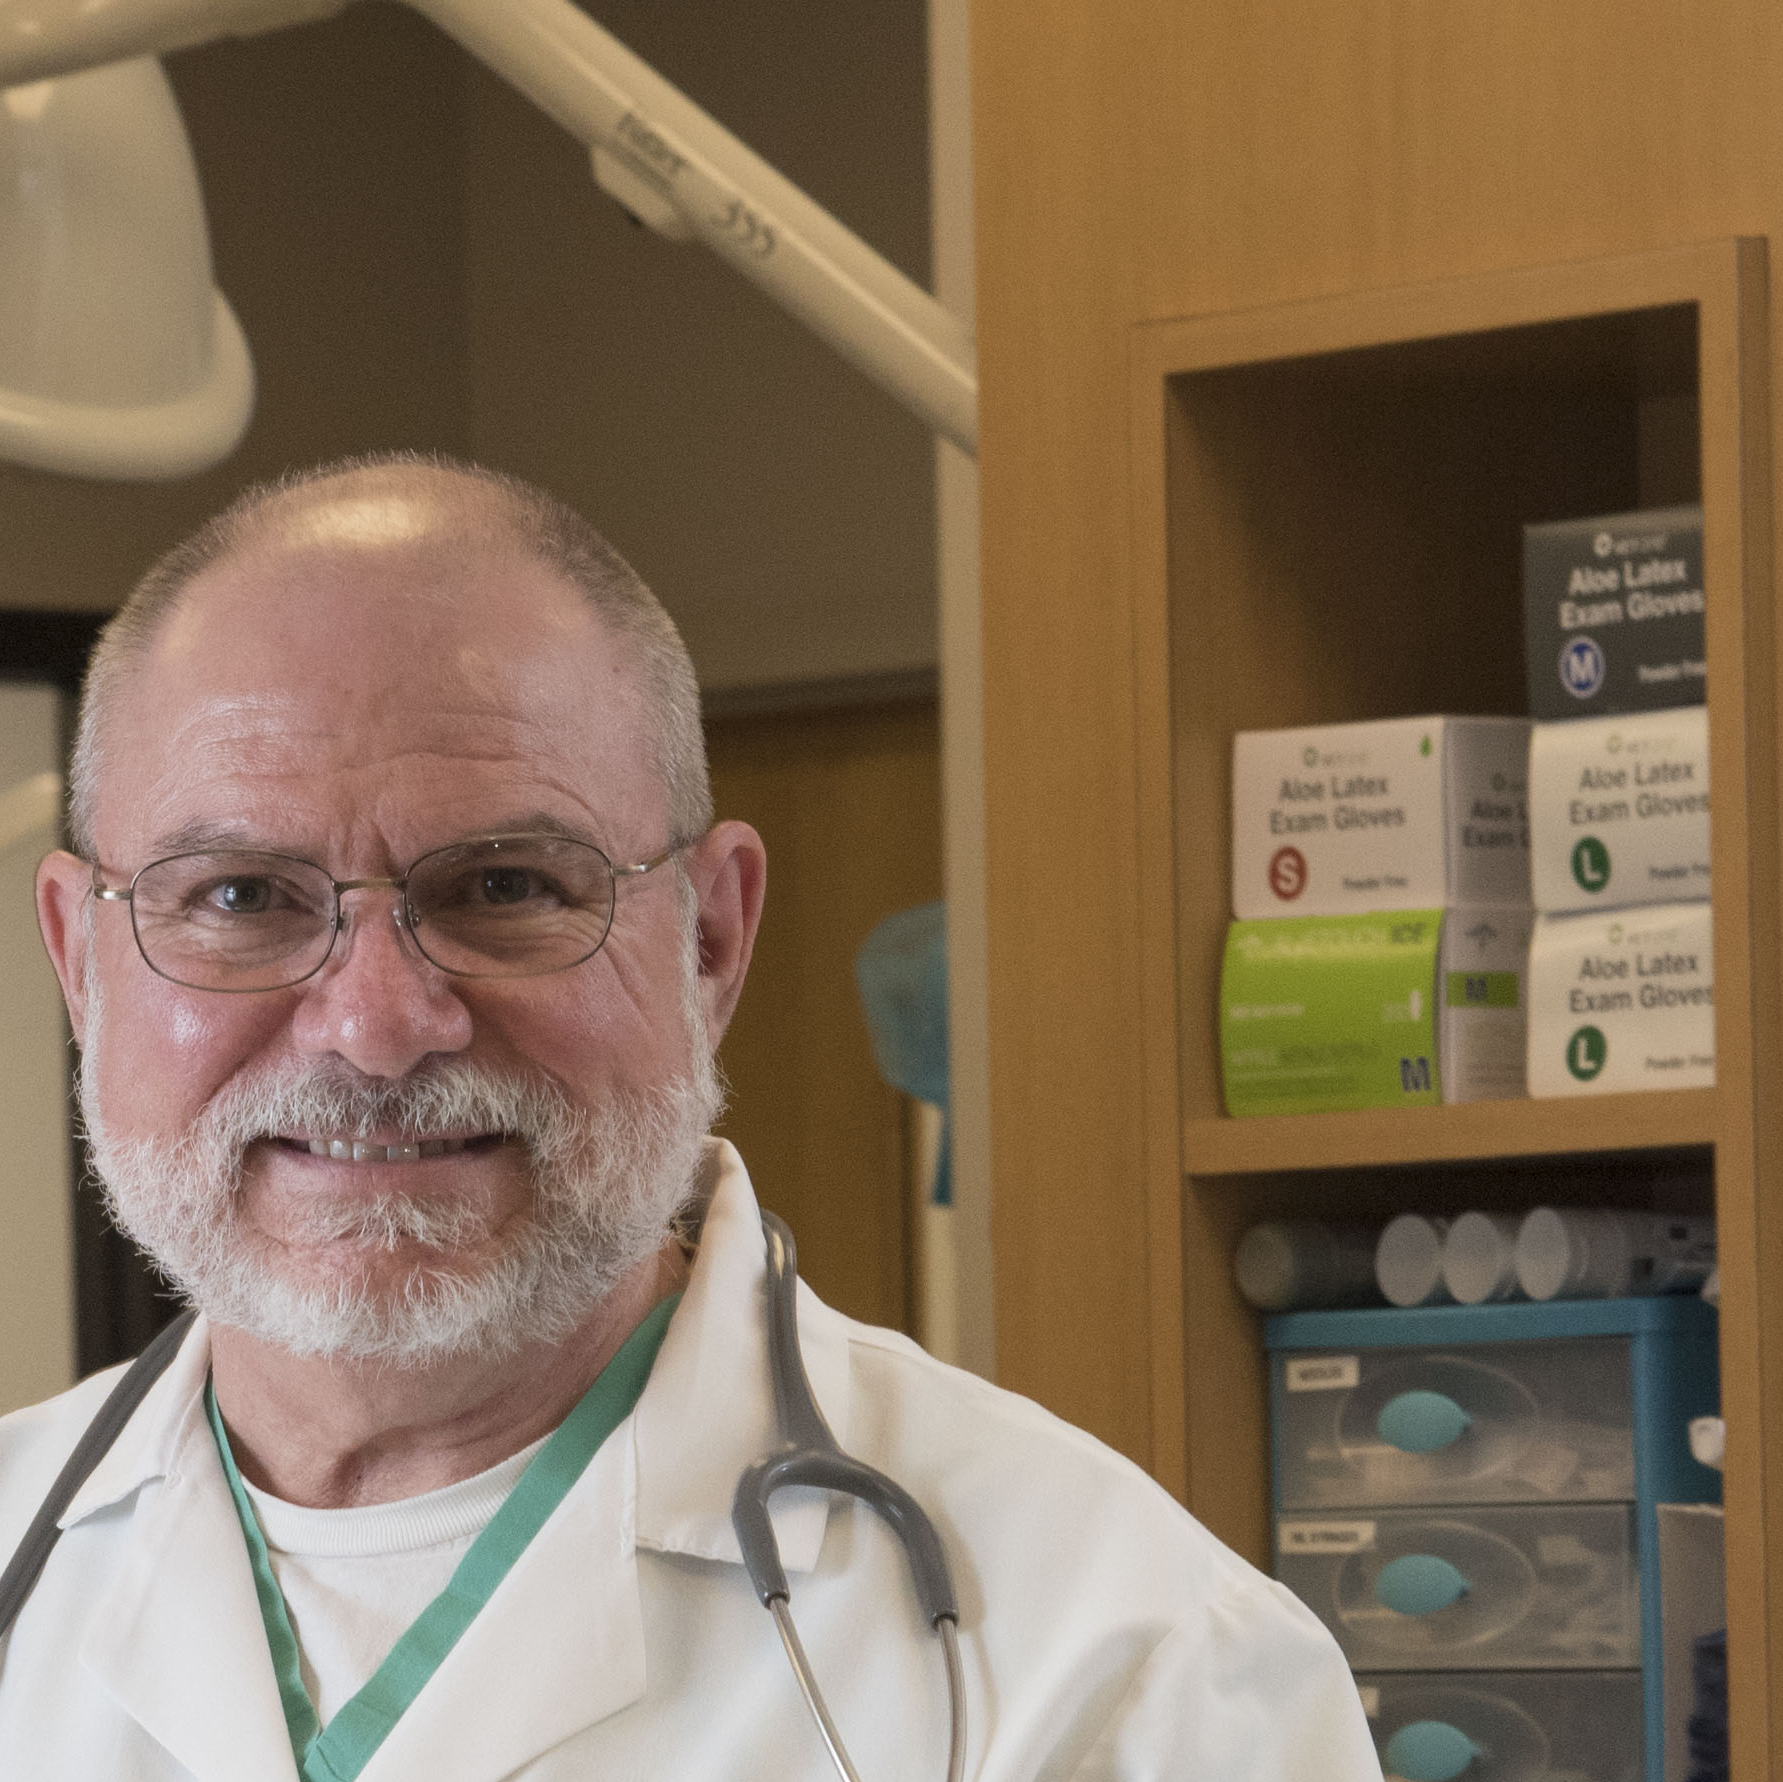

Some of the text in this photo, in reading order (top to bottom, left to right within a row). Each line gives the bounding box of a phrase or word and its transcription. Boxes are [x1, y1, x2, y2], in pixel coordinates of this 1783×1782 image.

[1570, 559, 1686, 595] Aloe Latex
[1560, 600, 1623, 630] Exam
[1280, 776, 1388, 800] Aloe Latex
[1581, 761, 1693, 790] Aloe Latex
[1270, 806, 1405, 834] Exam Gloves
[1570, 800, 1630, 826] Exam
[1579, 951, 1698, 981] Aloe Latex
[1569, 989, 1632, 1018] Exam
